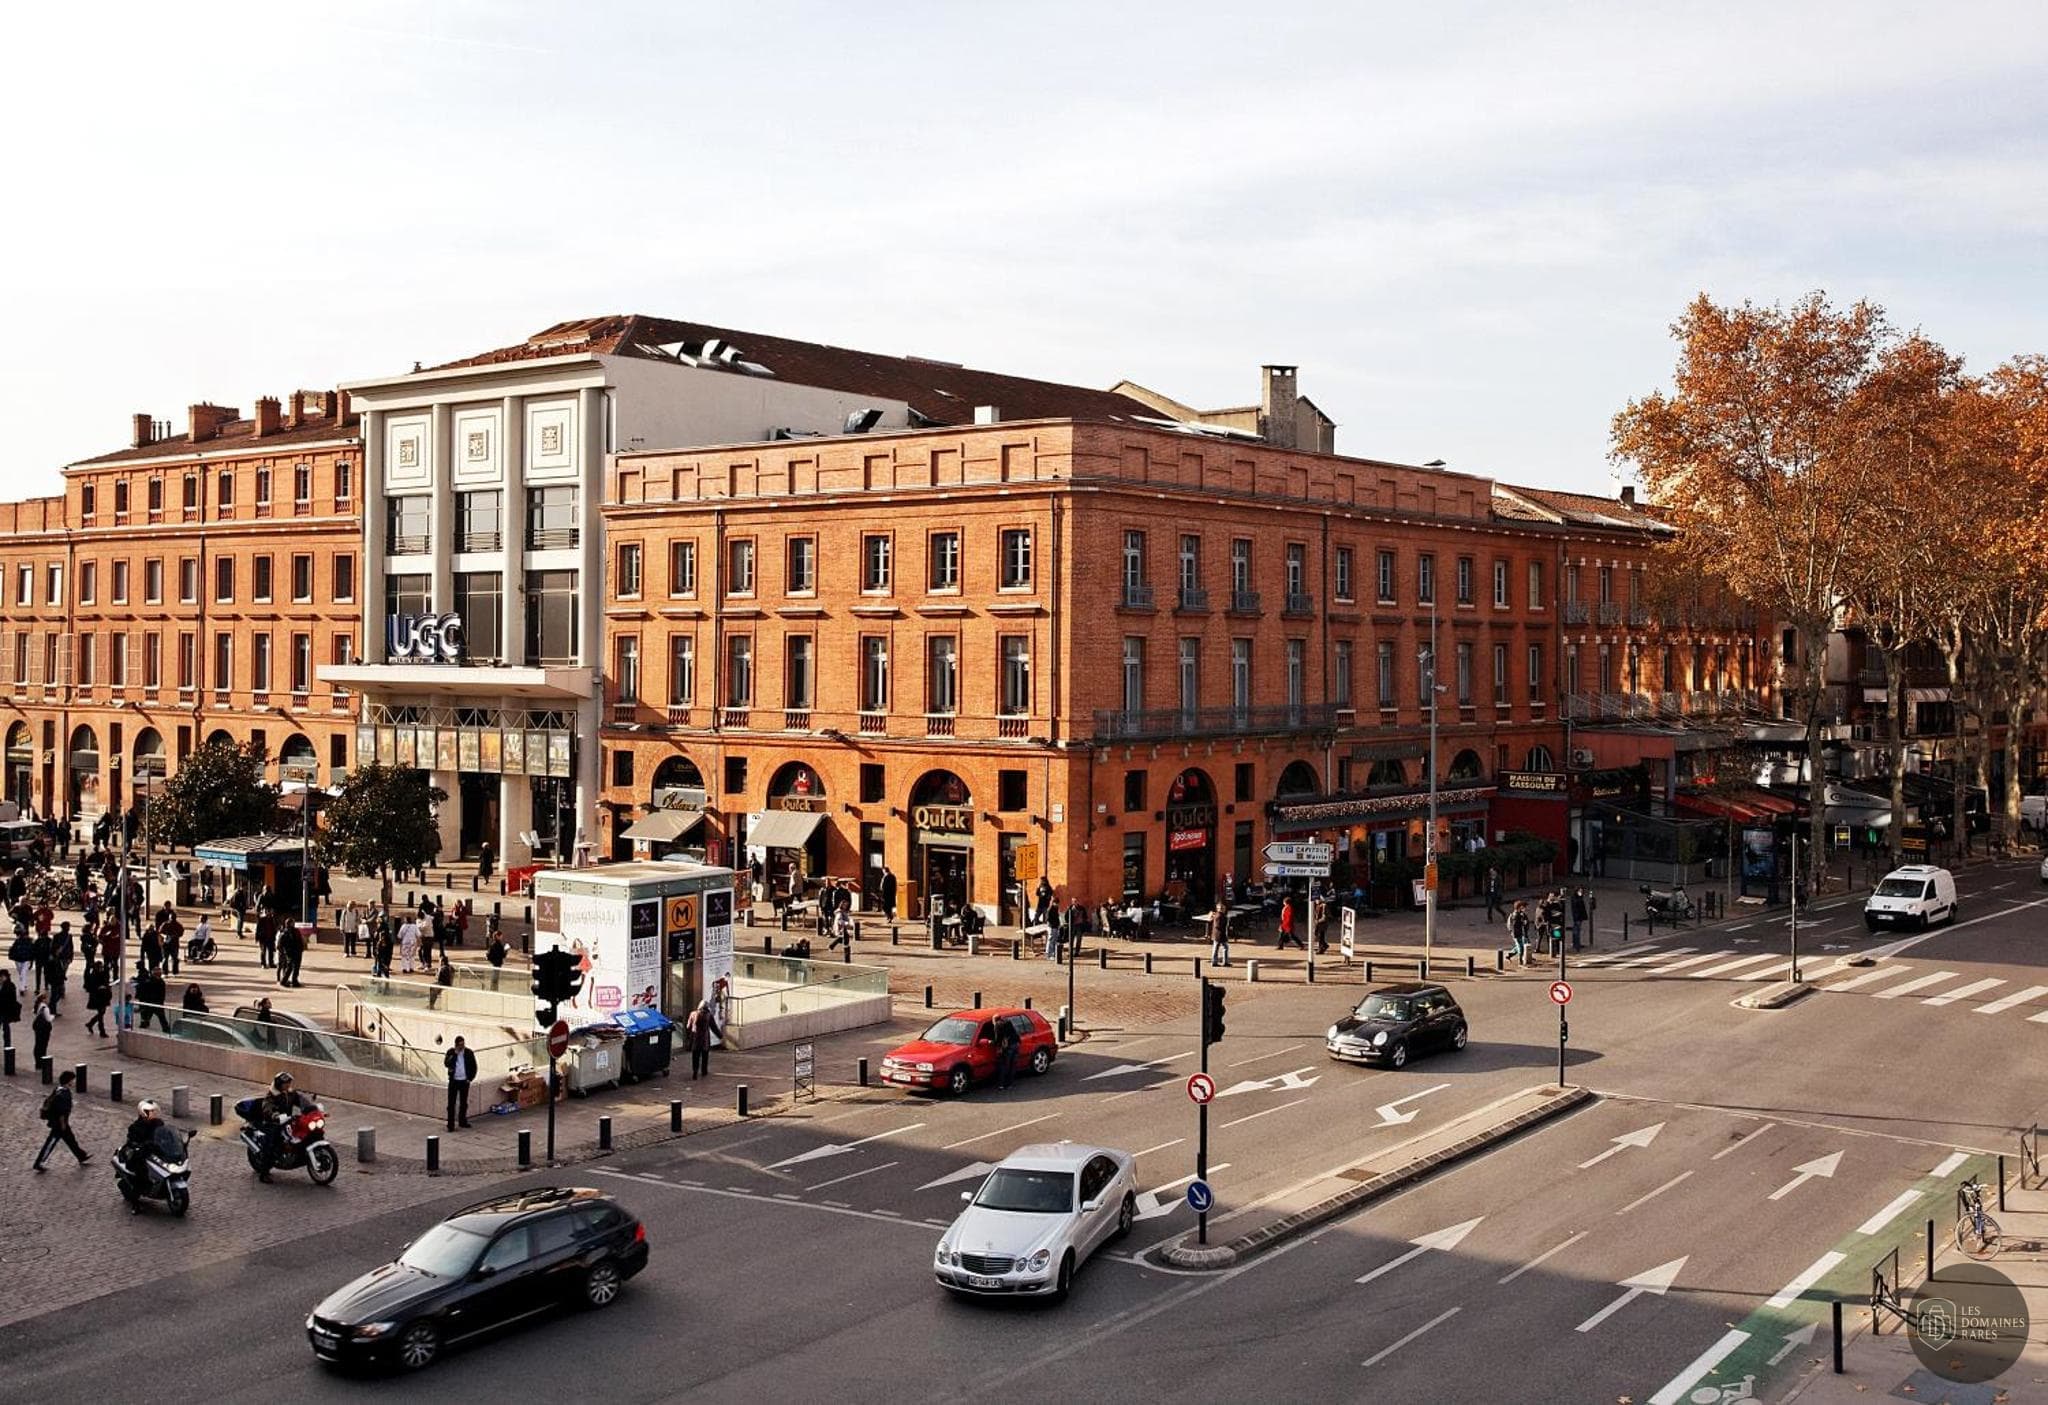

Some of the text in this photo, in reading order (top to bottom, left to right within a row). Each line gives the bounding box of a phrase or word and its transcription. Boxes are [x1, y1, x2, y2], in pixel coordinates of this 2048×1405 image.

[388, 612, 462, 658] UGC
[1509, 781, 1556, 790] CASSOULET
[781, 797, 812, 812] Quick
[915, 806, 968, 830] Quick
[1172, 808, 1213, 830] Quick
[1310, 867, 1328, 875] Hugo
[675, 905, 689, 921] M
